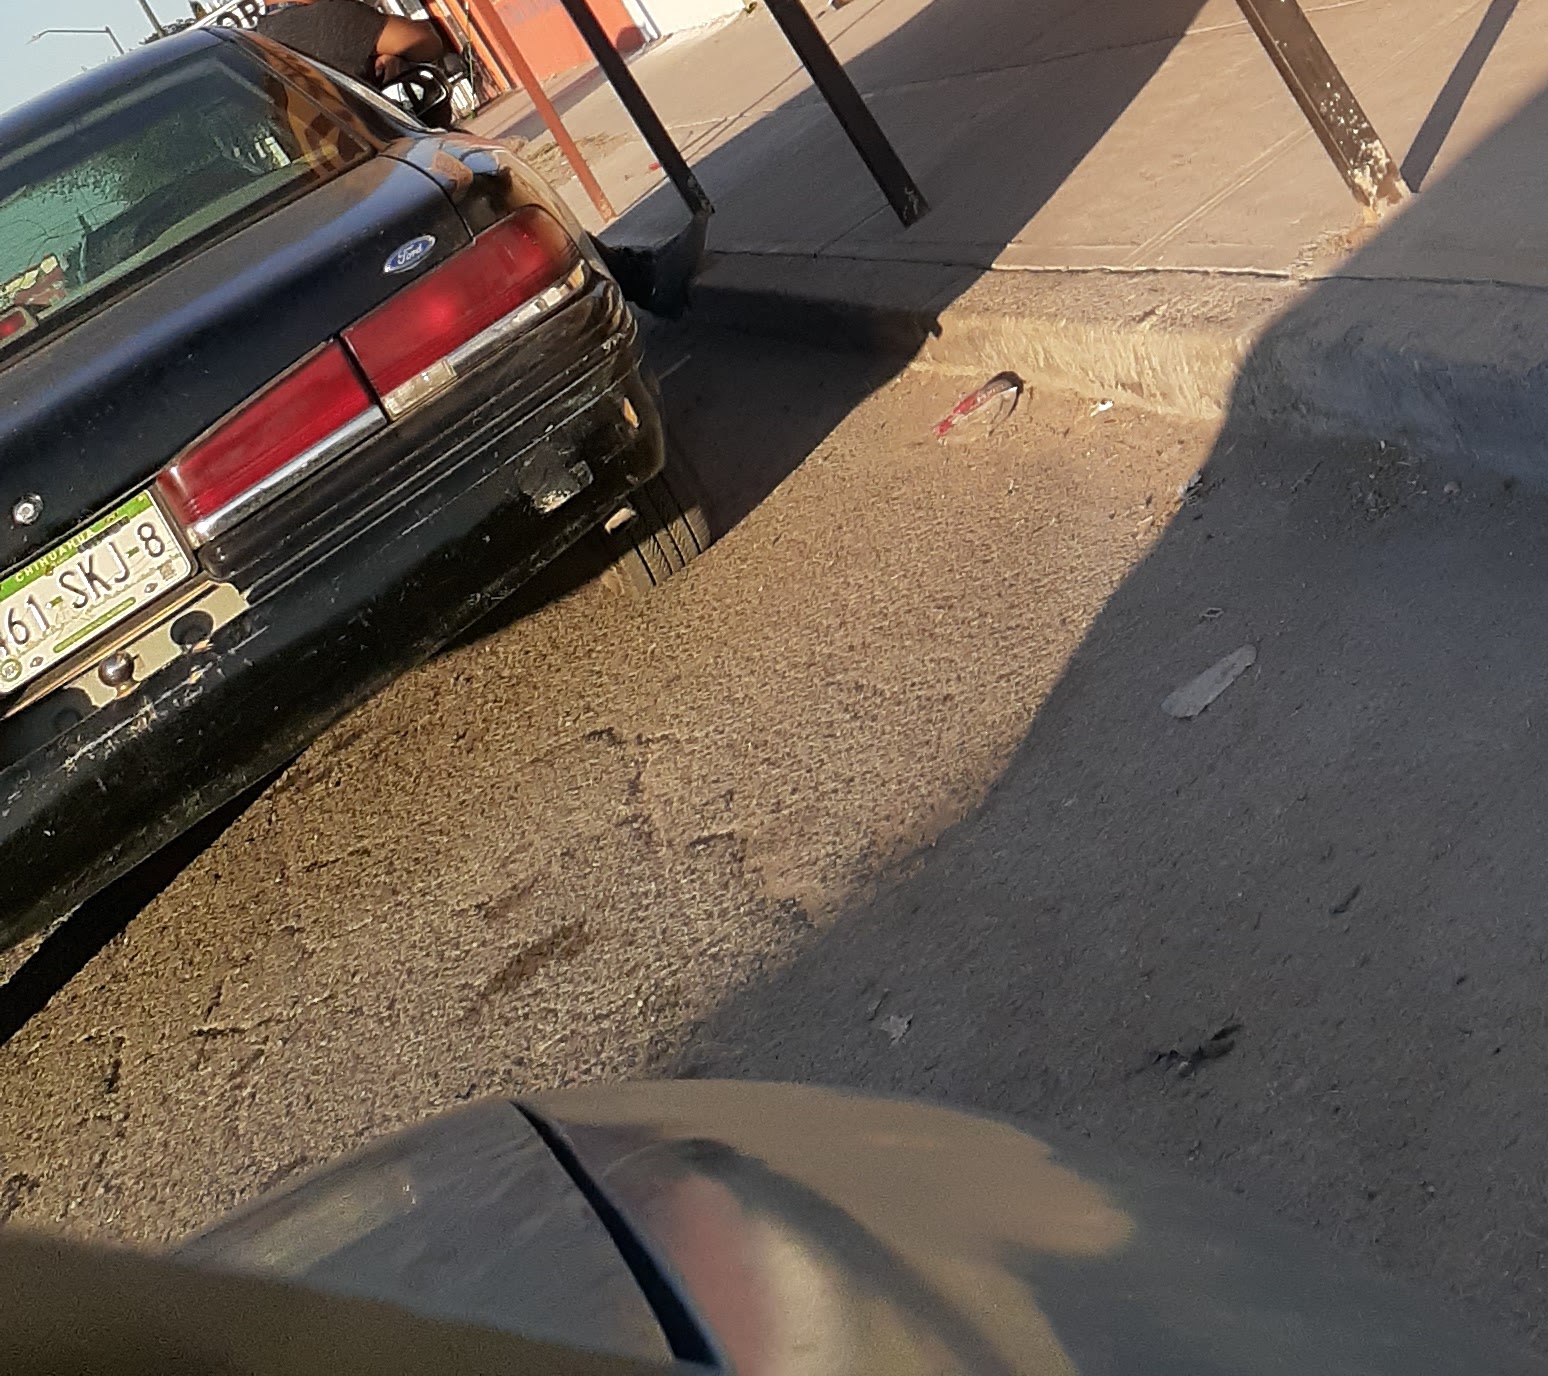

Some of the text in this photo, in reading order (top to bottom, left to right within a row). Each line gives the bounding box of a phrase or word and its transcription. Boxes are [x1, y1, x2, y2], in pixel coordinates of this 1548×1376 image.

[396, 242, 423, 265] Ford
[15, 528, 97, 583] CHIHUAHUA
[0, 522, 166, 650] 61-SKJ-8
